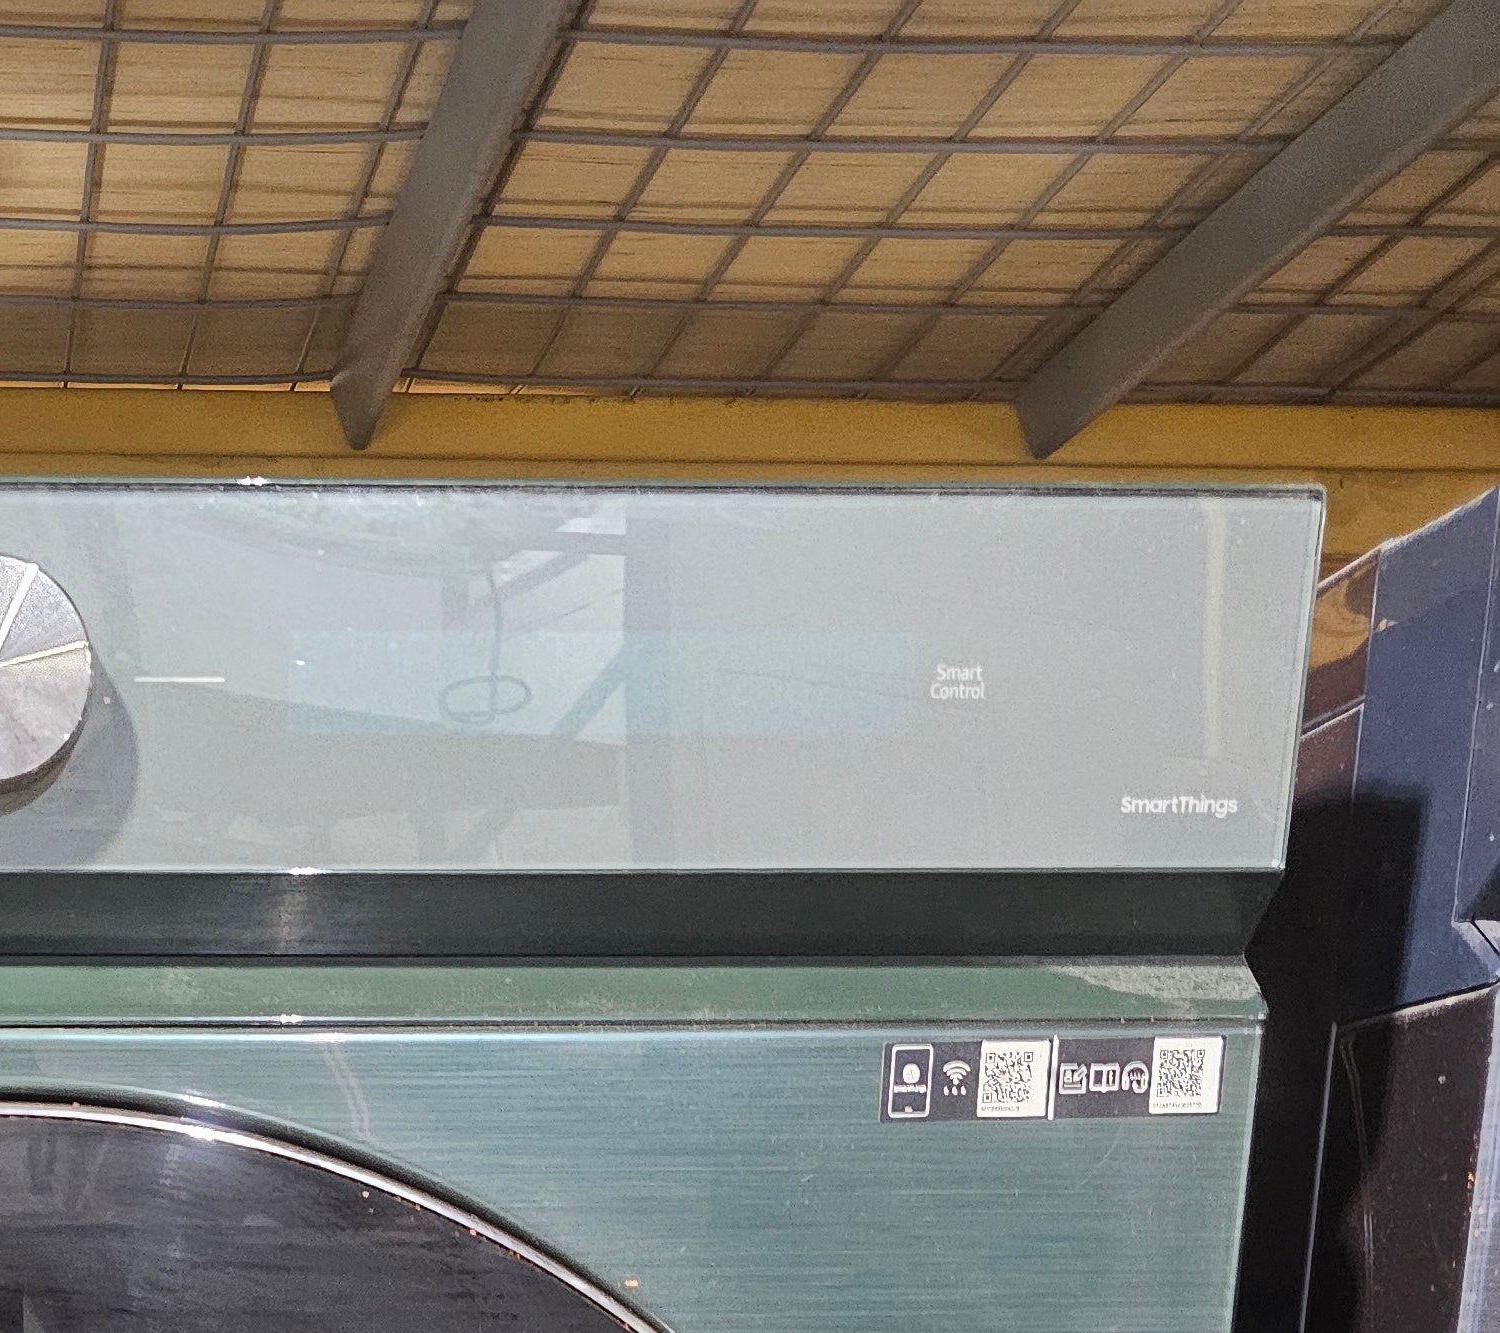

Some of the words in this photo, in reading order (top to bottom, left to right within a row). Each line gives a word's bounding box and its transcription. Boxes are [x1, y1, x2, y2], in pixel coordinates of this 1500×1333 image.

[936, 664, 982, 682] Smart
[930, 683, 985, 700] Control
[1120, 796, 1238, 818] SmartThings
